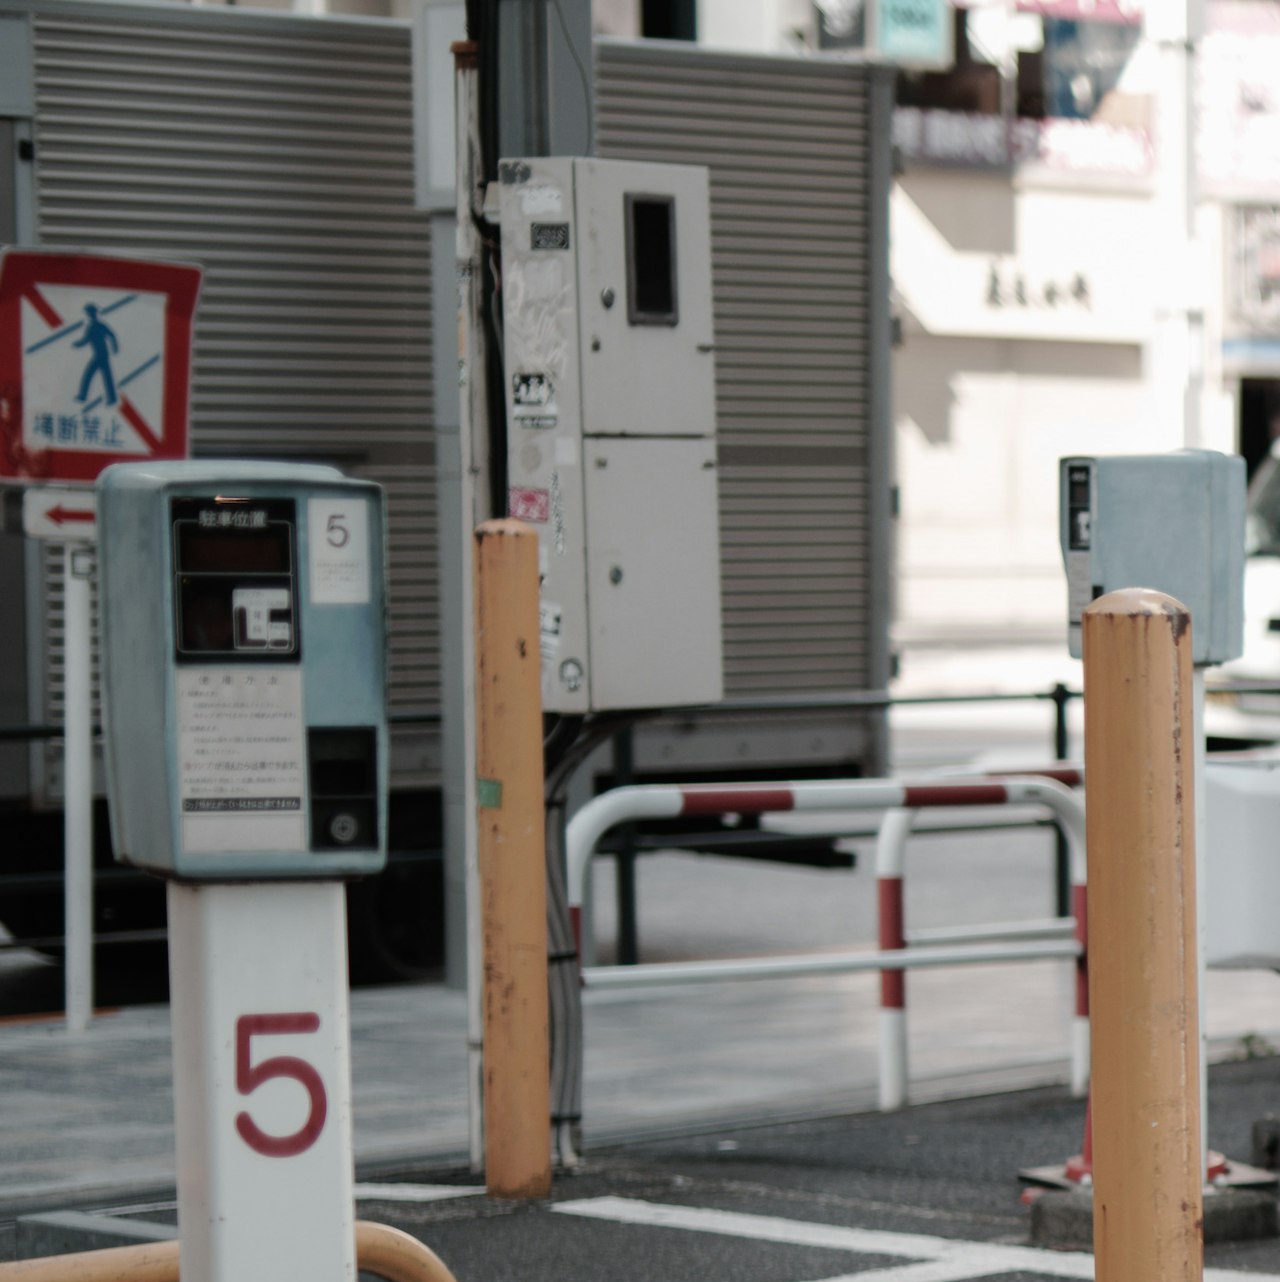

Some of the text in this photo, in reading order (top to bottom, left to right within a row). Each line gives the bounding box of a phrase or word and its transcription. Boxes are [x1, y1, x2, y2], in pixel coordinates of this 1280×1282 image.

[199, 511, 268, 528] 駐車位置
[326, 514, 349, 548] 5
[234, 1011, 327, 1158] 5
